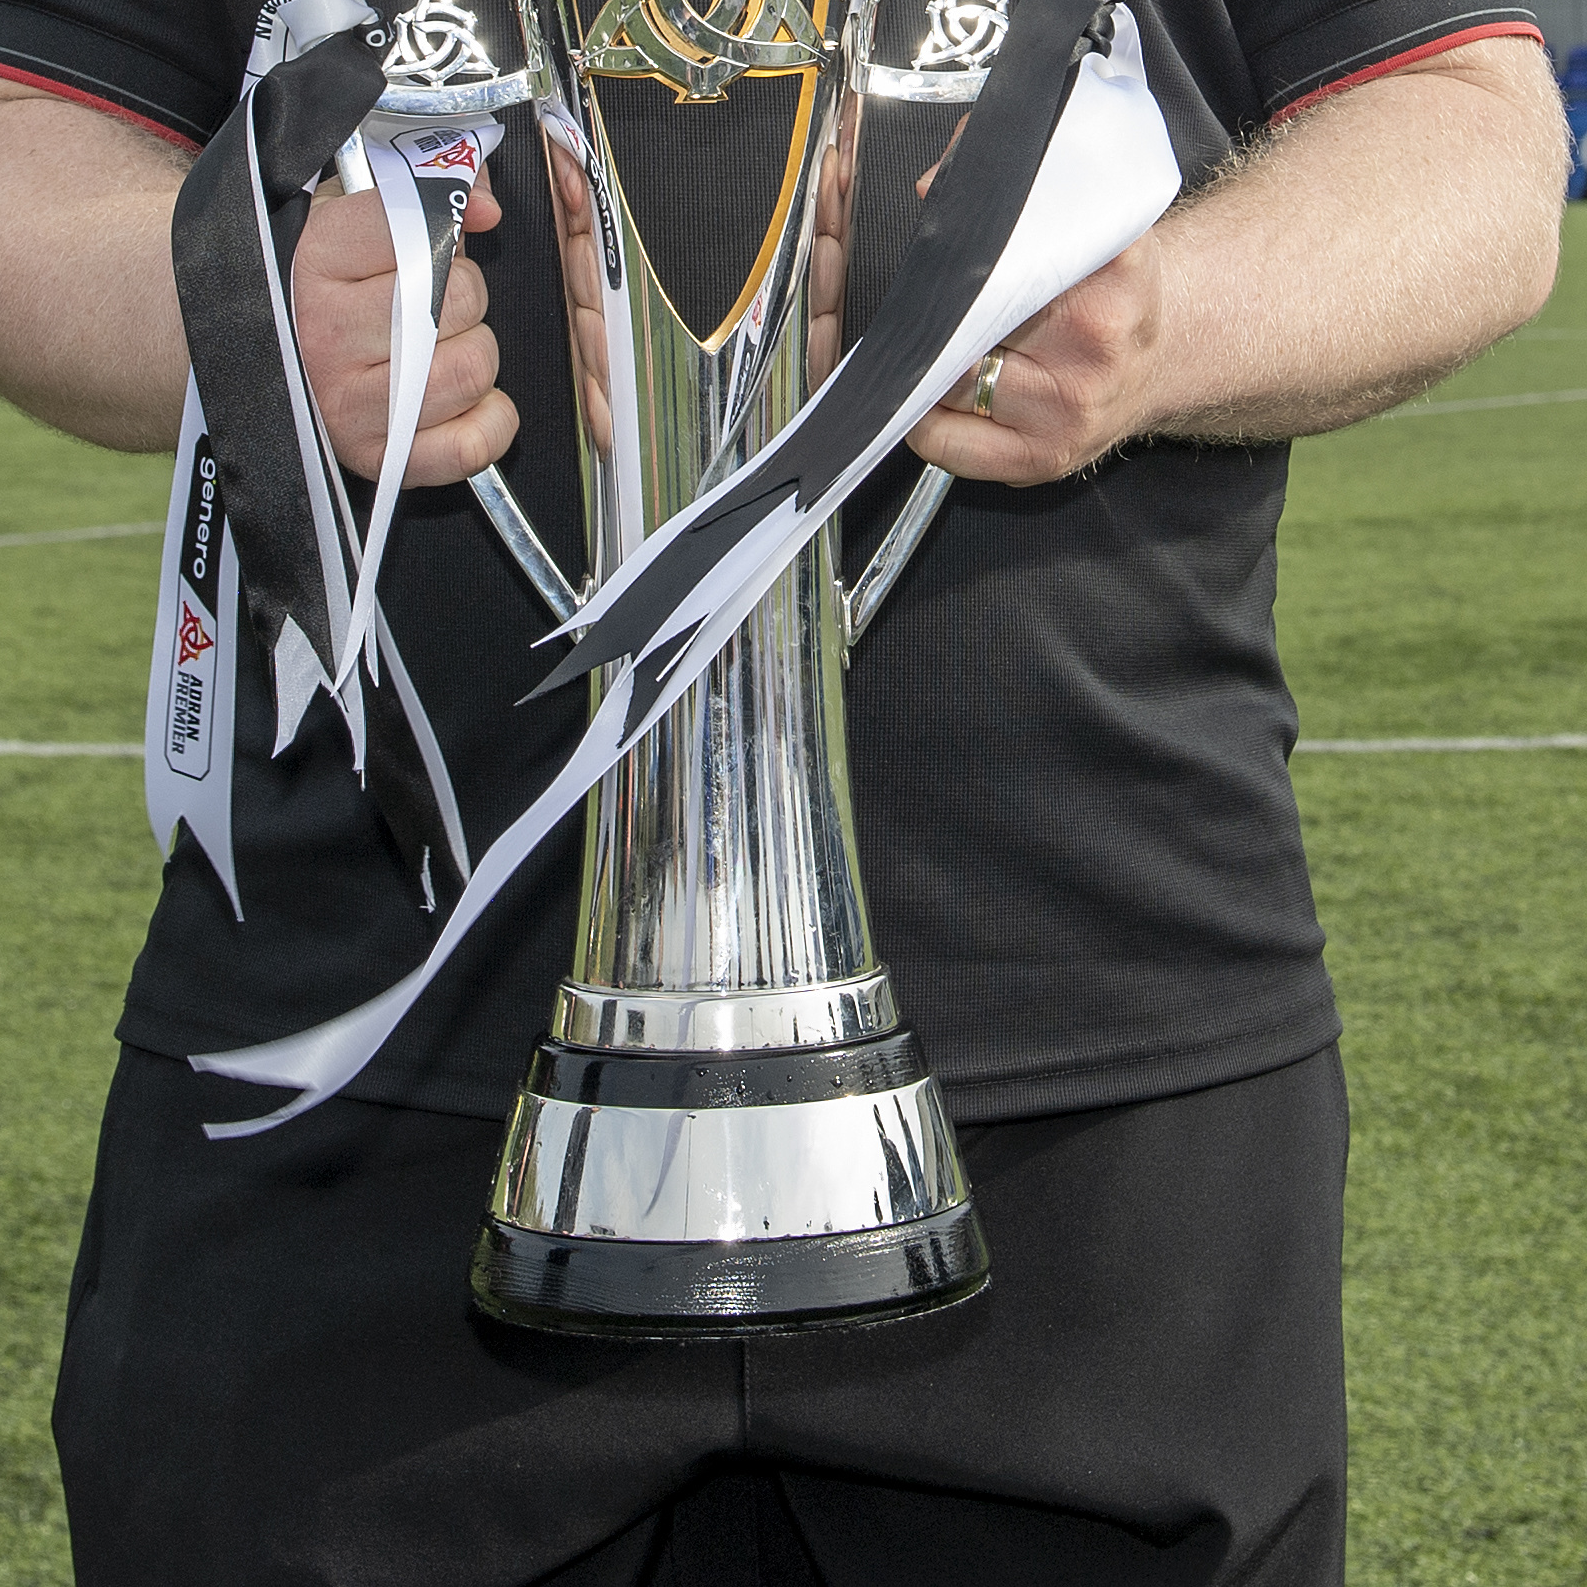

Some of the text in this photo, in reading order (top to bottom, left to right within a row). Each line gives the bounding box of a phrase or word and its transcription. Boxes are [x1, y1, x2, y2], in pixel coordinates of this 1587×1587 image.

[192, 456, 216, 579] genero
[171, 670, 190, 755] PREMIER
[186, 673, 204, 742] ADRAN
